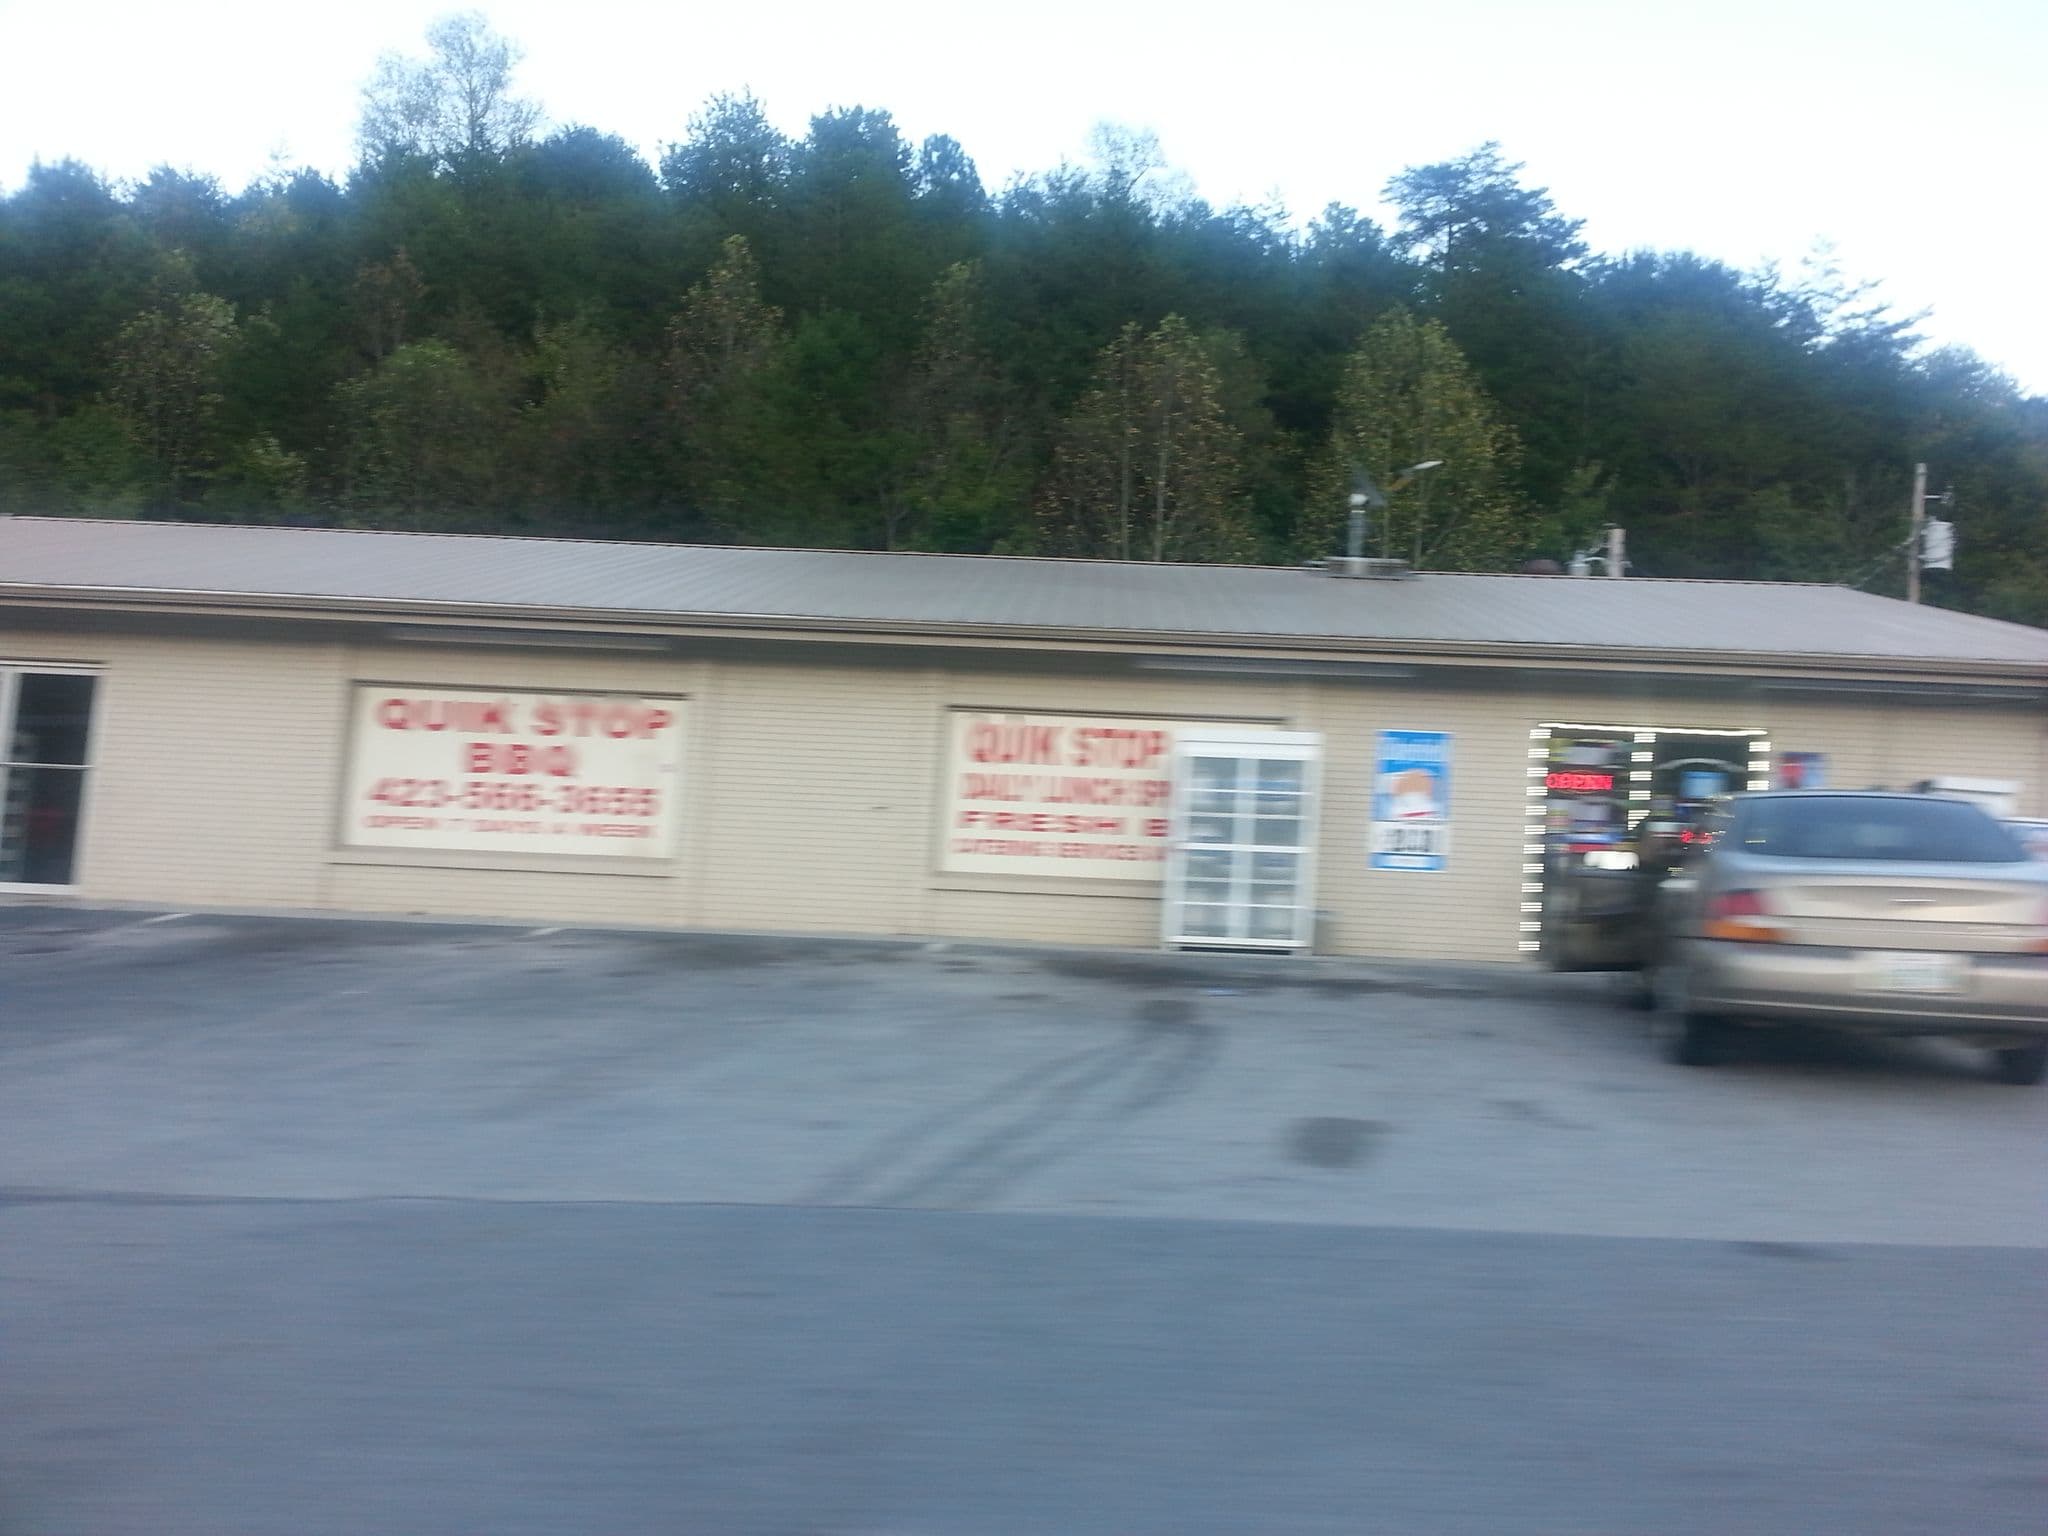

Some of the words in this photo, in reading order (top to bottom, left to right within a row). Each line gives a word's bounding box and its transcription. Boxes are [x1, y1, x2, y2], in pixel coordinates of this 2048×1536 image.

[374, 699, 515, 734] QUIK
[528, 703, 674, 740] STOP
[462, 742, 582, 777] BBQ
[967, 723, 1064, 765] QUIK
[1071, 727, 1168, 769] STOP
[1040, 775, 1129, 805] LUNCH
[957, 811, 1126, 835] FRESH
